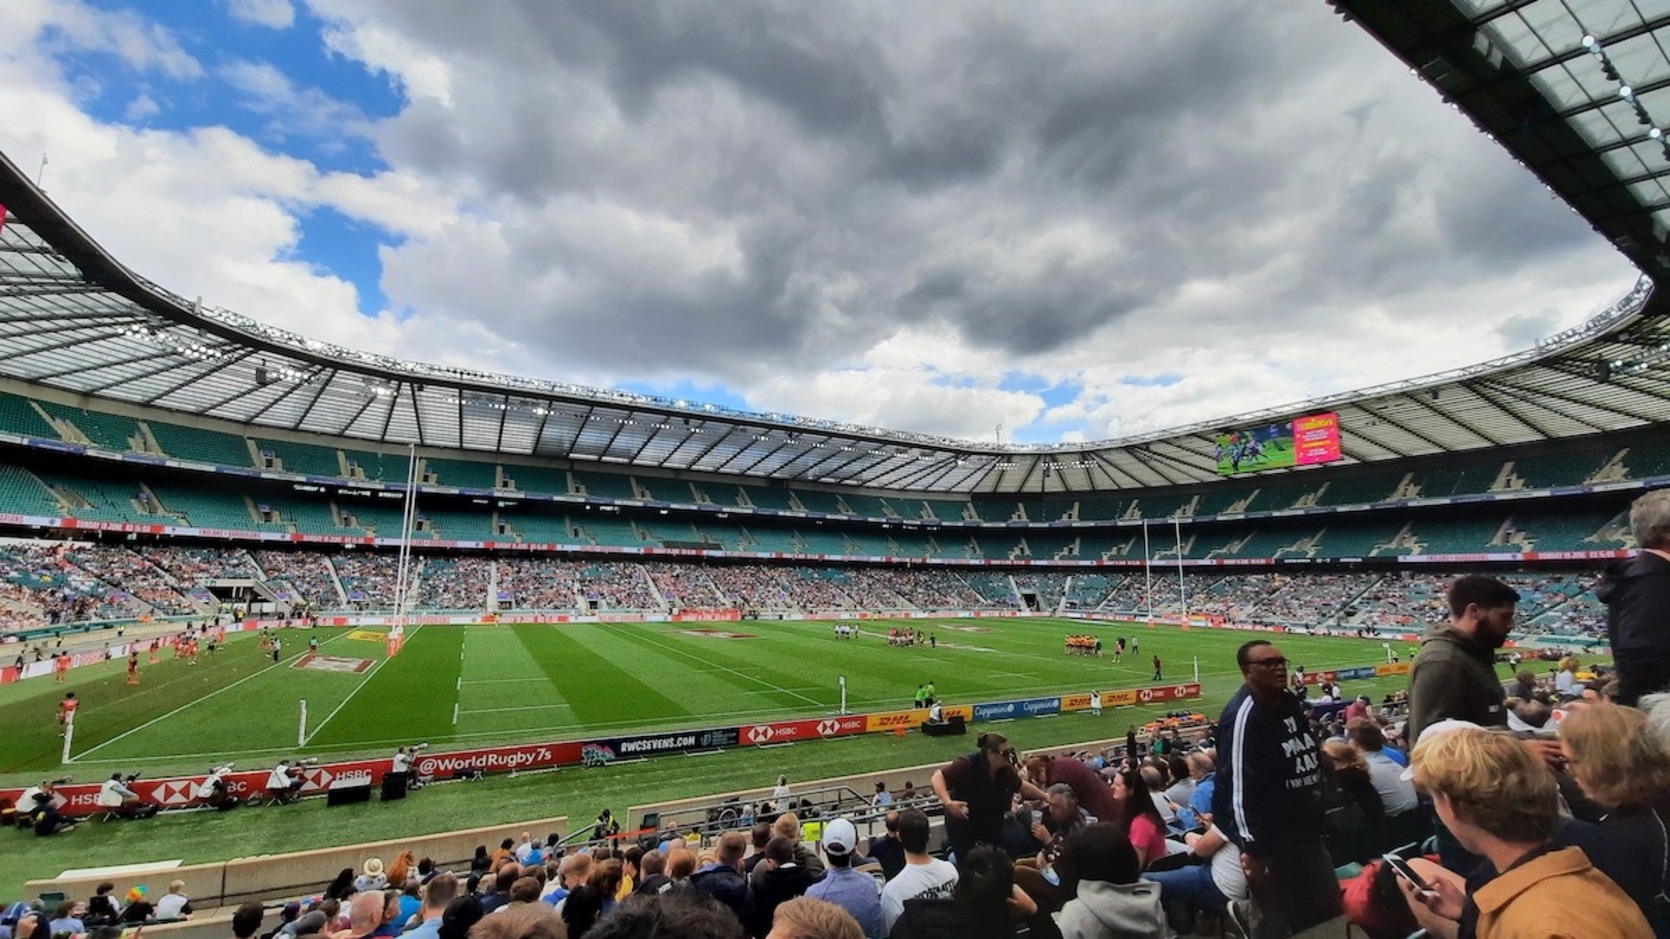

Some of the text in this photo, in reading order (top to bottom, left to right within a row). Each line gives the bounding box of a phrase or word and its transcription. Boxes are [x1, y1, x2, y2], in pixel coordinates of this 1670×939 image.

[1107, 694, 1130, 702] DHL
[841, 720, 861, 729] HSBC
[879, 715, 912, 726] DHL
[775, 727, 797, 736] HSBC
[621, 736, 696, 753] RWCSEVENS.COM
[335, 768, 372, 782] HSBC
